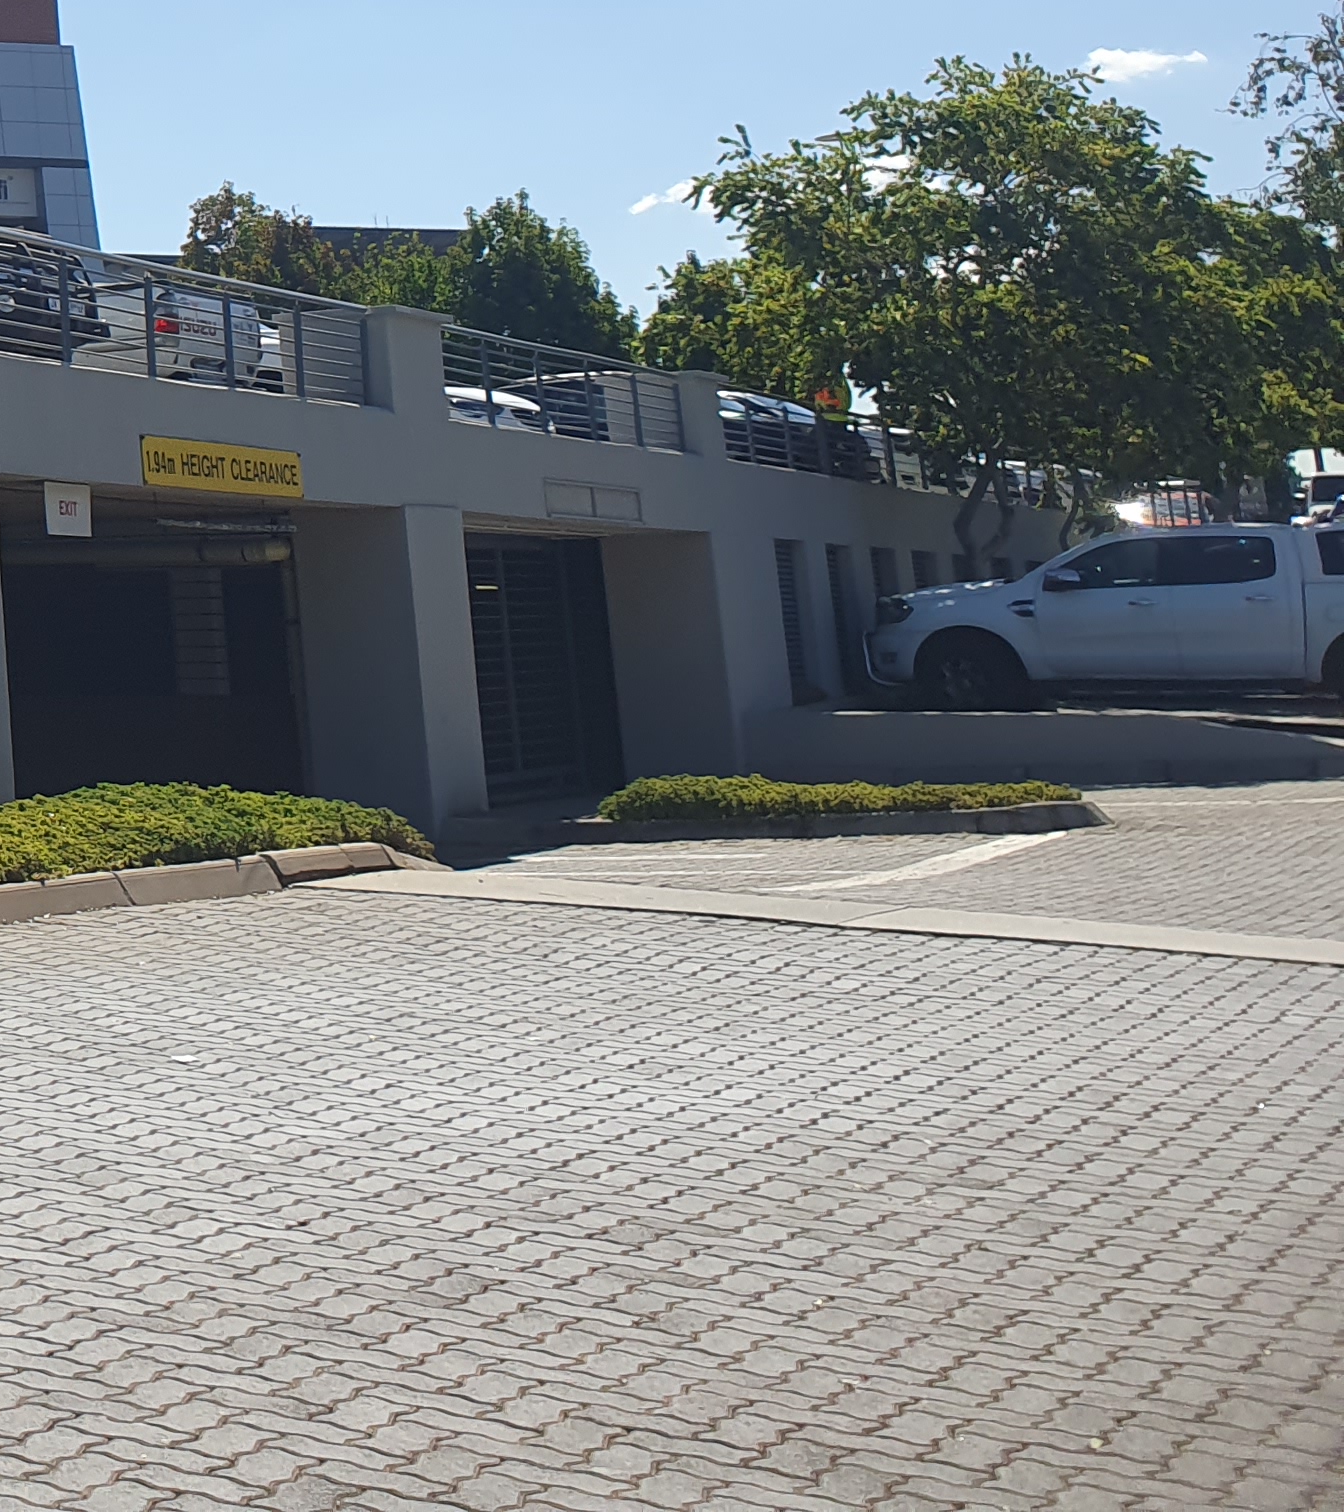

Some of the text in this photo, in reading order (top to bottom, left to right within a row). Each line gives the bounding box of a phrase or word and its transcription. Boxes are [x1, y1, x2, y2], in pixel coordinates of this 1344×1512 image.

[181, 452, 226, 477] HEIGHT
[230, 458, 299, 486] CLEARANCE
[59, 500, 78, 517] EXIT
